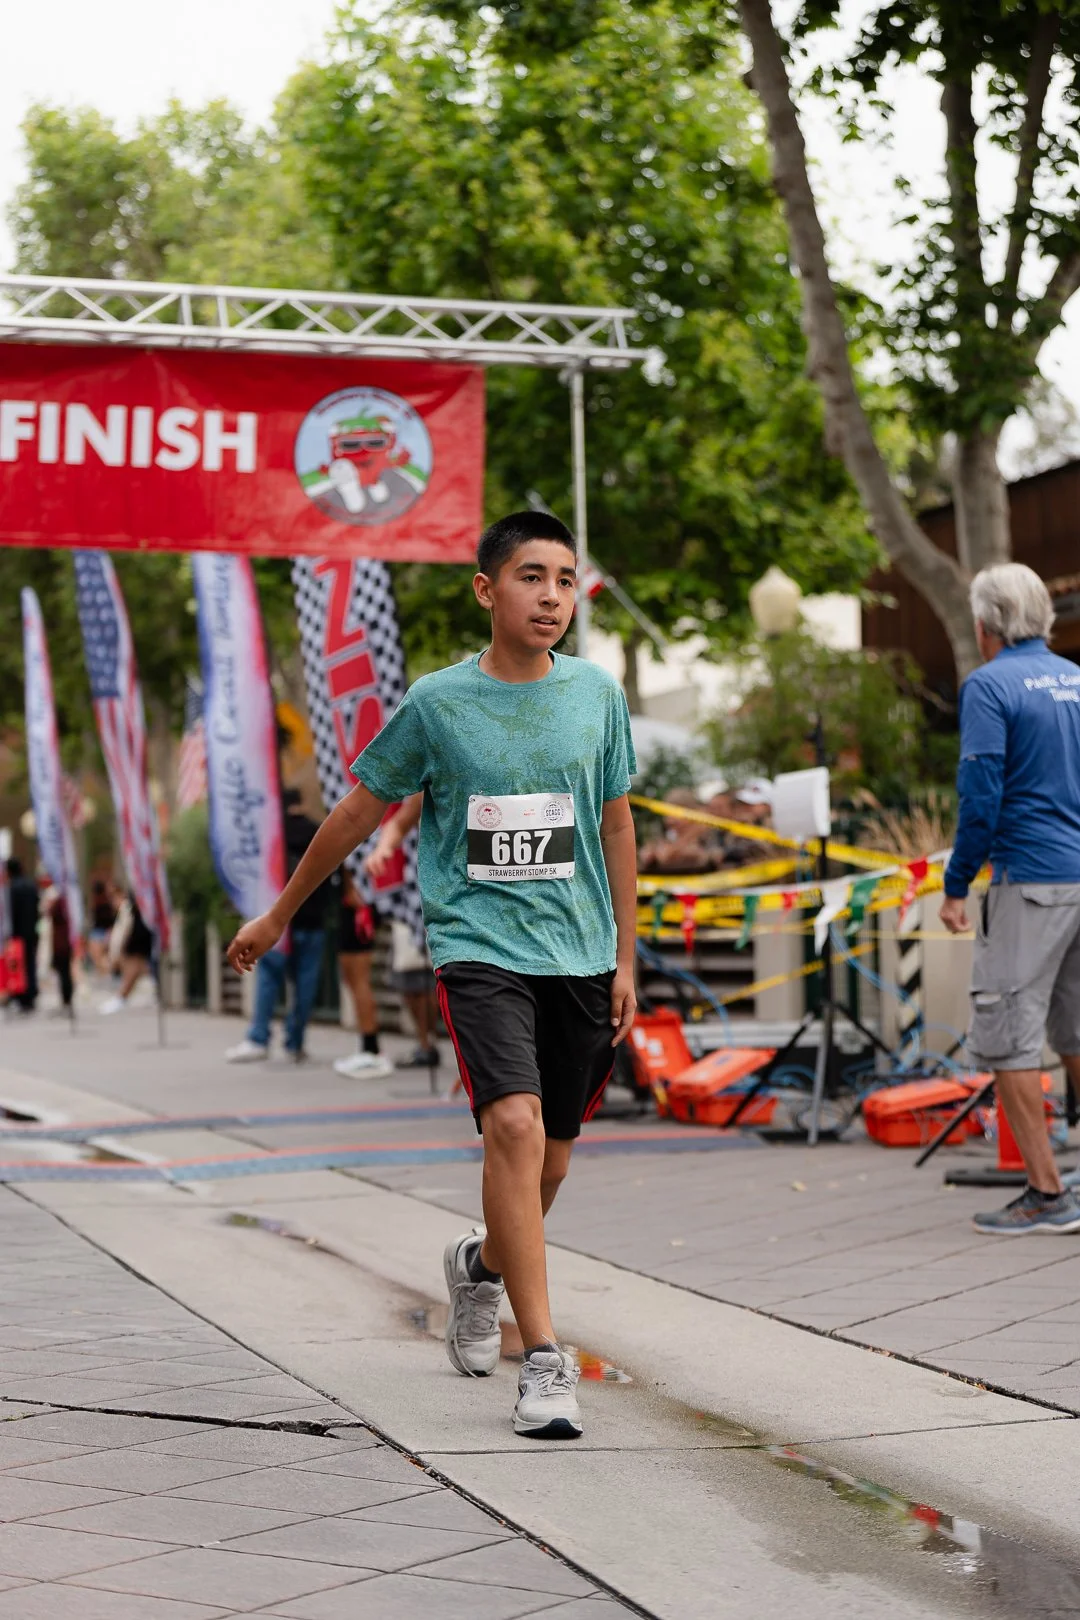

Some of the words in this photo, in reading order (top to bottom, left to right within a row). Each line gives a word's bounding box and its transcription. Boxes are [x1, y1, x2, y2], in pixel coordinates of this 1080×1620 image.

[0, 400, 257, 472] FINISH
[491, 830, 552, 865] 667
[488, 869, 527, 877] STRAWBERRY
[528, 868, 548, 876] STOMP
[549, 867, 557, 875] 5K
